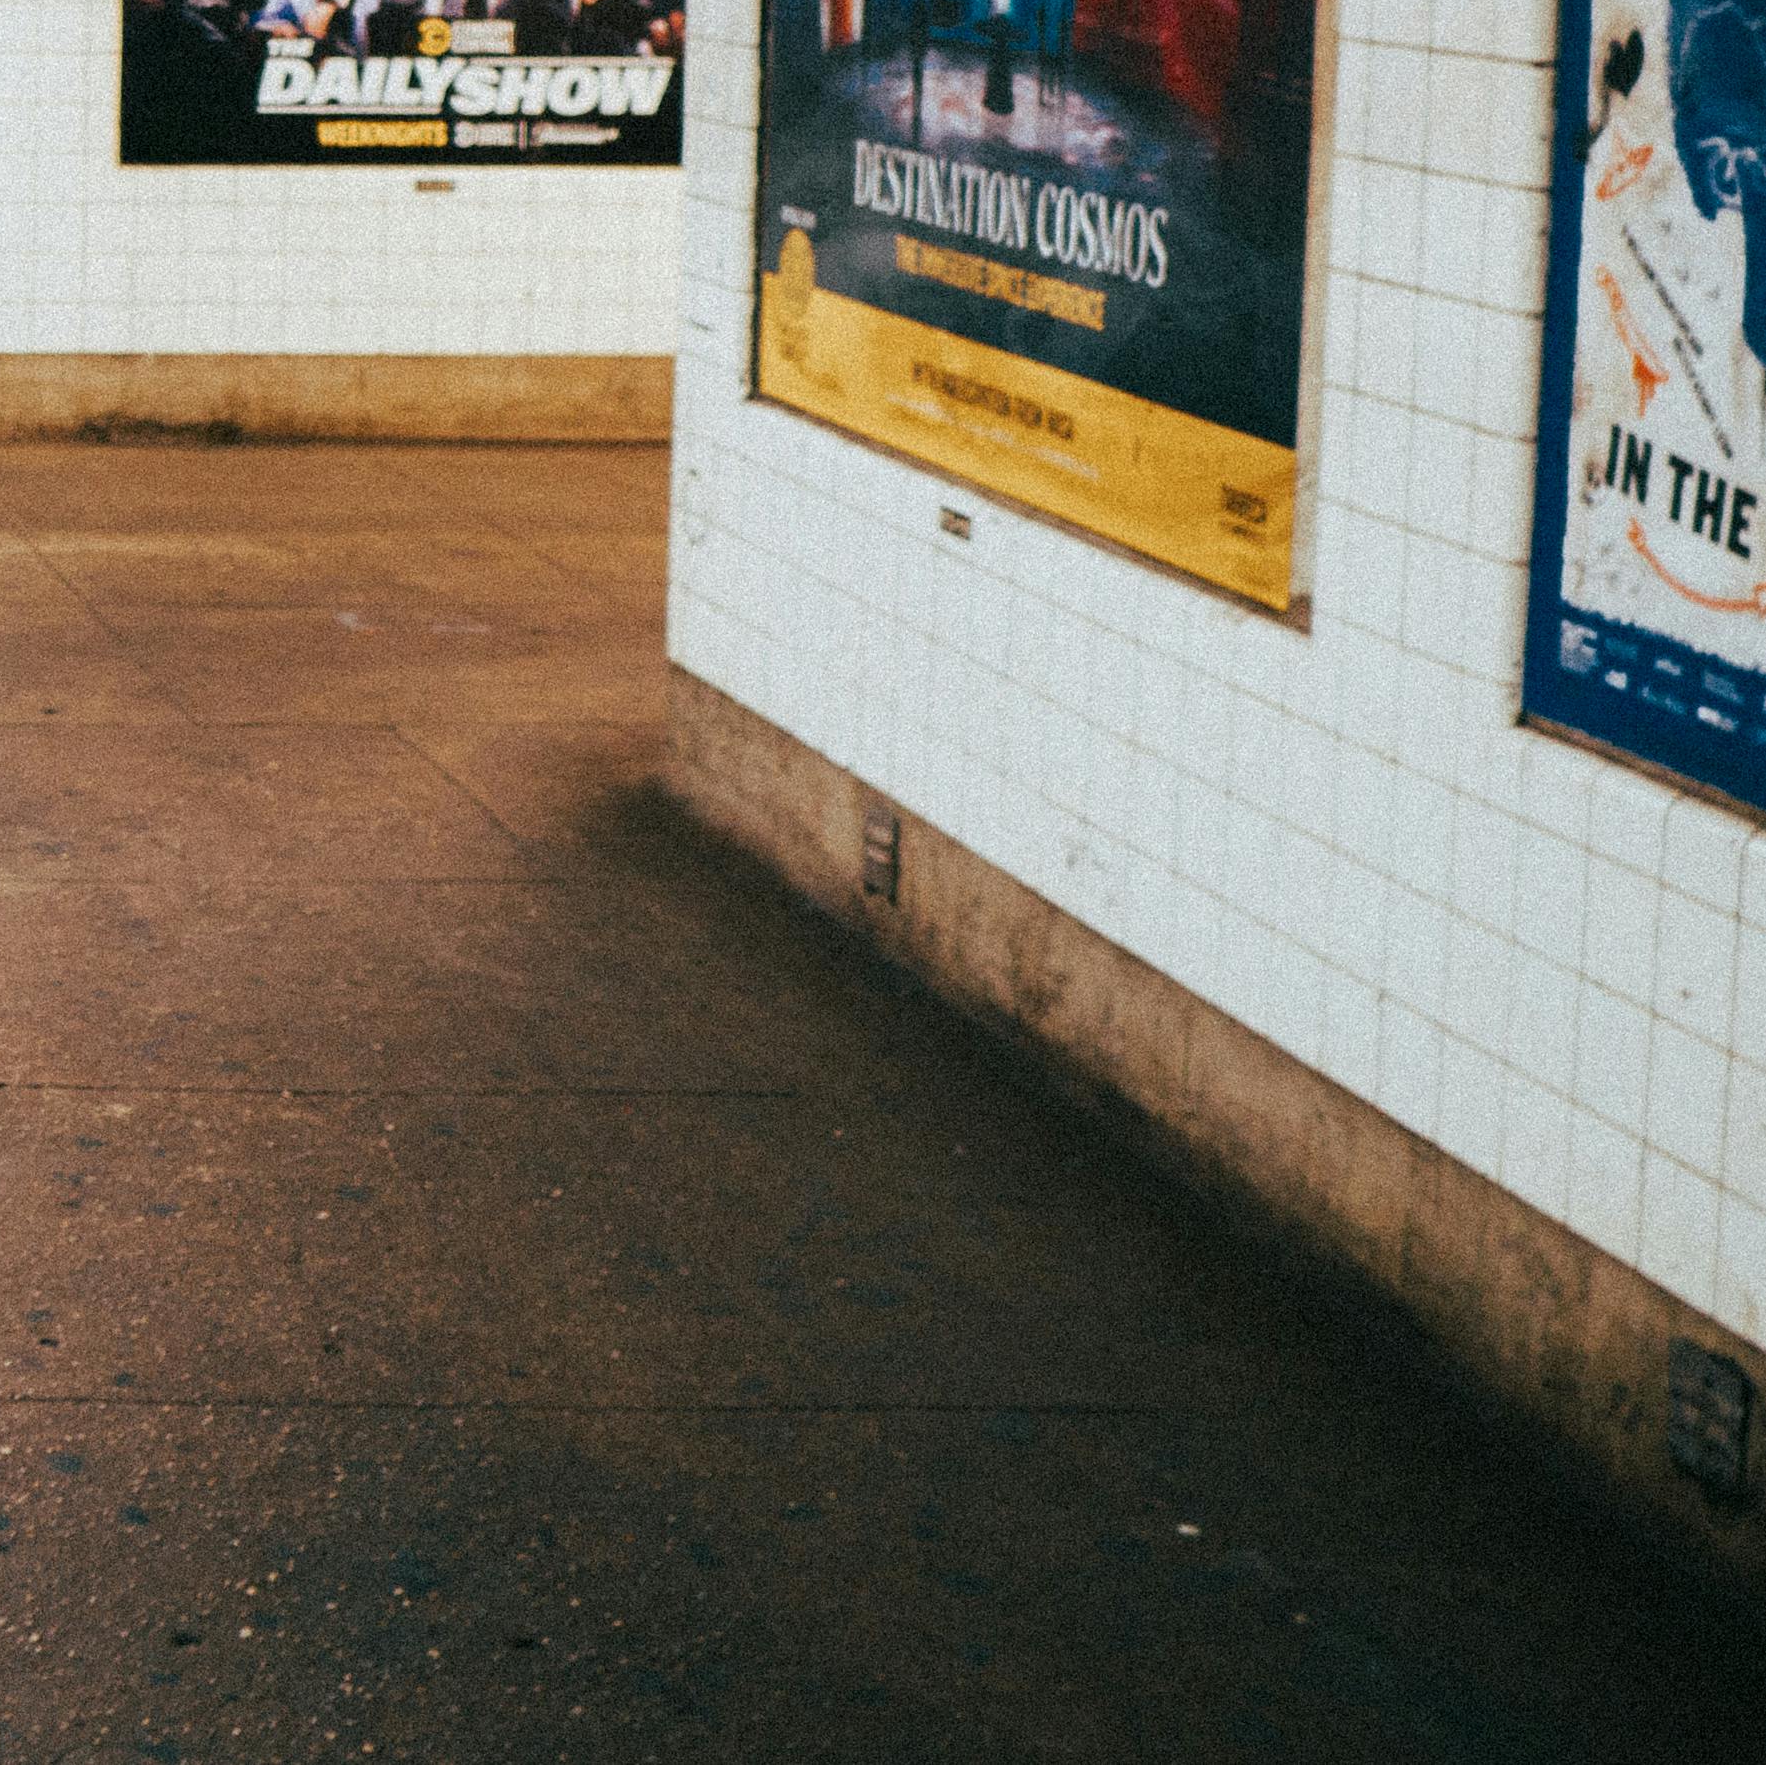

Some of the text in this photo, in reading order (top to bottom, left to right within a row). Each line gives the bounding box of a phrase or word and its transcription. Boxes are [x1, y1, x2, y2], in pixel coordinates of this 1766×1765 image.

[257, 58, 673, 116] DAILY SHOW
[854, 139, 1169, 289] DESTINATION COSMOS
[1604, 422, 1758, 561] IN THE
